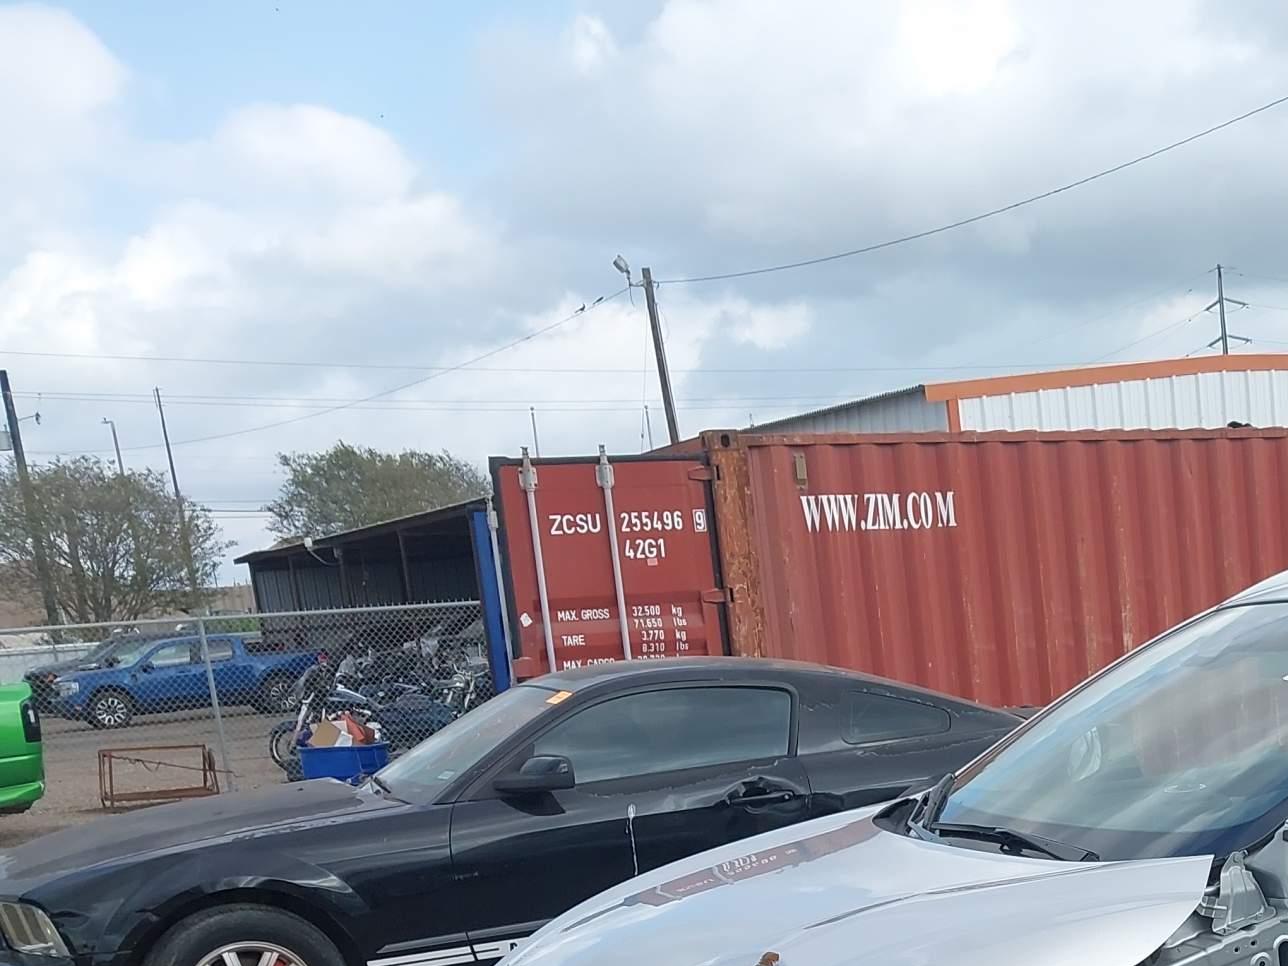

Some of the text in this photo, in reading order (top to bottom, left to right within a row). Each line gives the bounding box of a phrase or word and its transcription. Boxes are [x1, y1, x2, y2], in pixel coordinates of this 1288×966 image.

[549, 511, 706, 535] ZCSU 255496 9
[625, 538, 666, 559] 42G1
[557, 604, 682, 622] MAX. GROSS 32.500 kg
[633, 616, 687, 629] 71.650 lbs
[561, 634, 586, 647] TARE
[675, 629, 687, 642] kg
[676, 640, 689, 651] lbs
